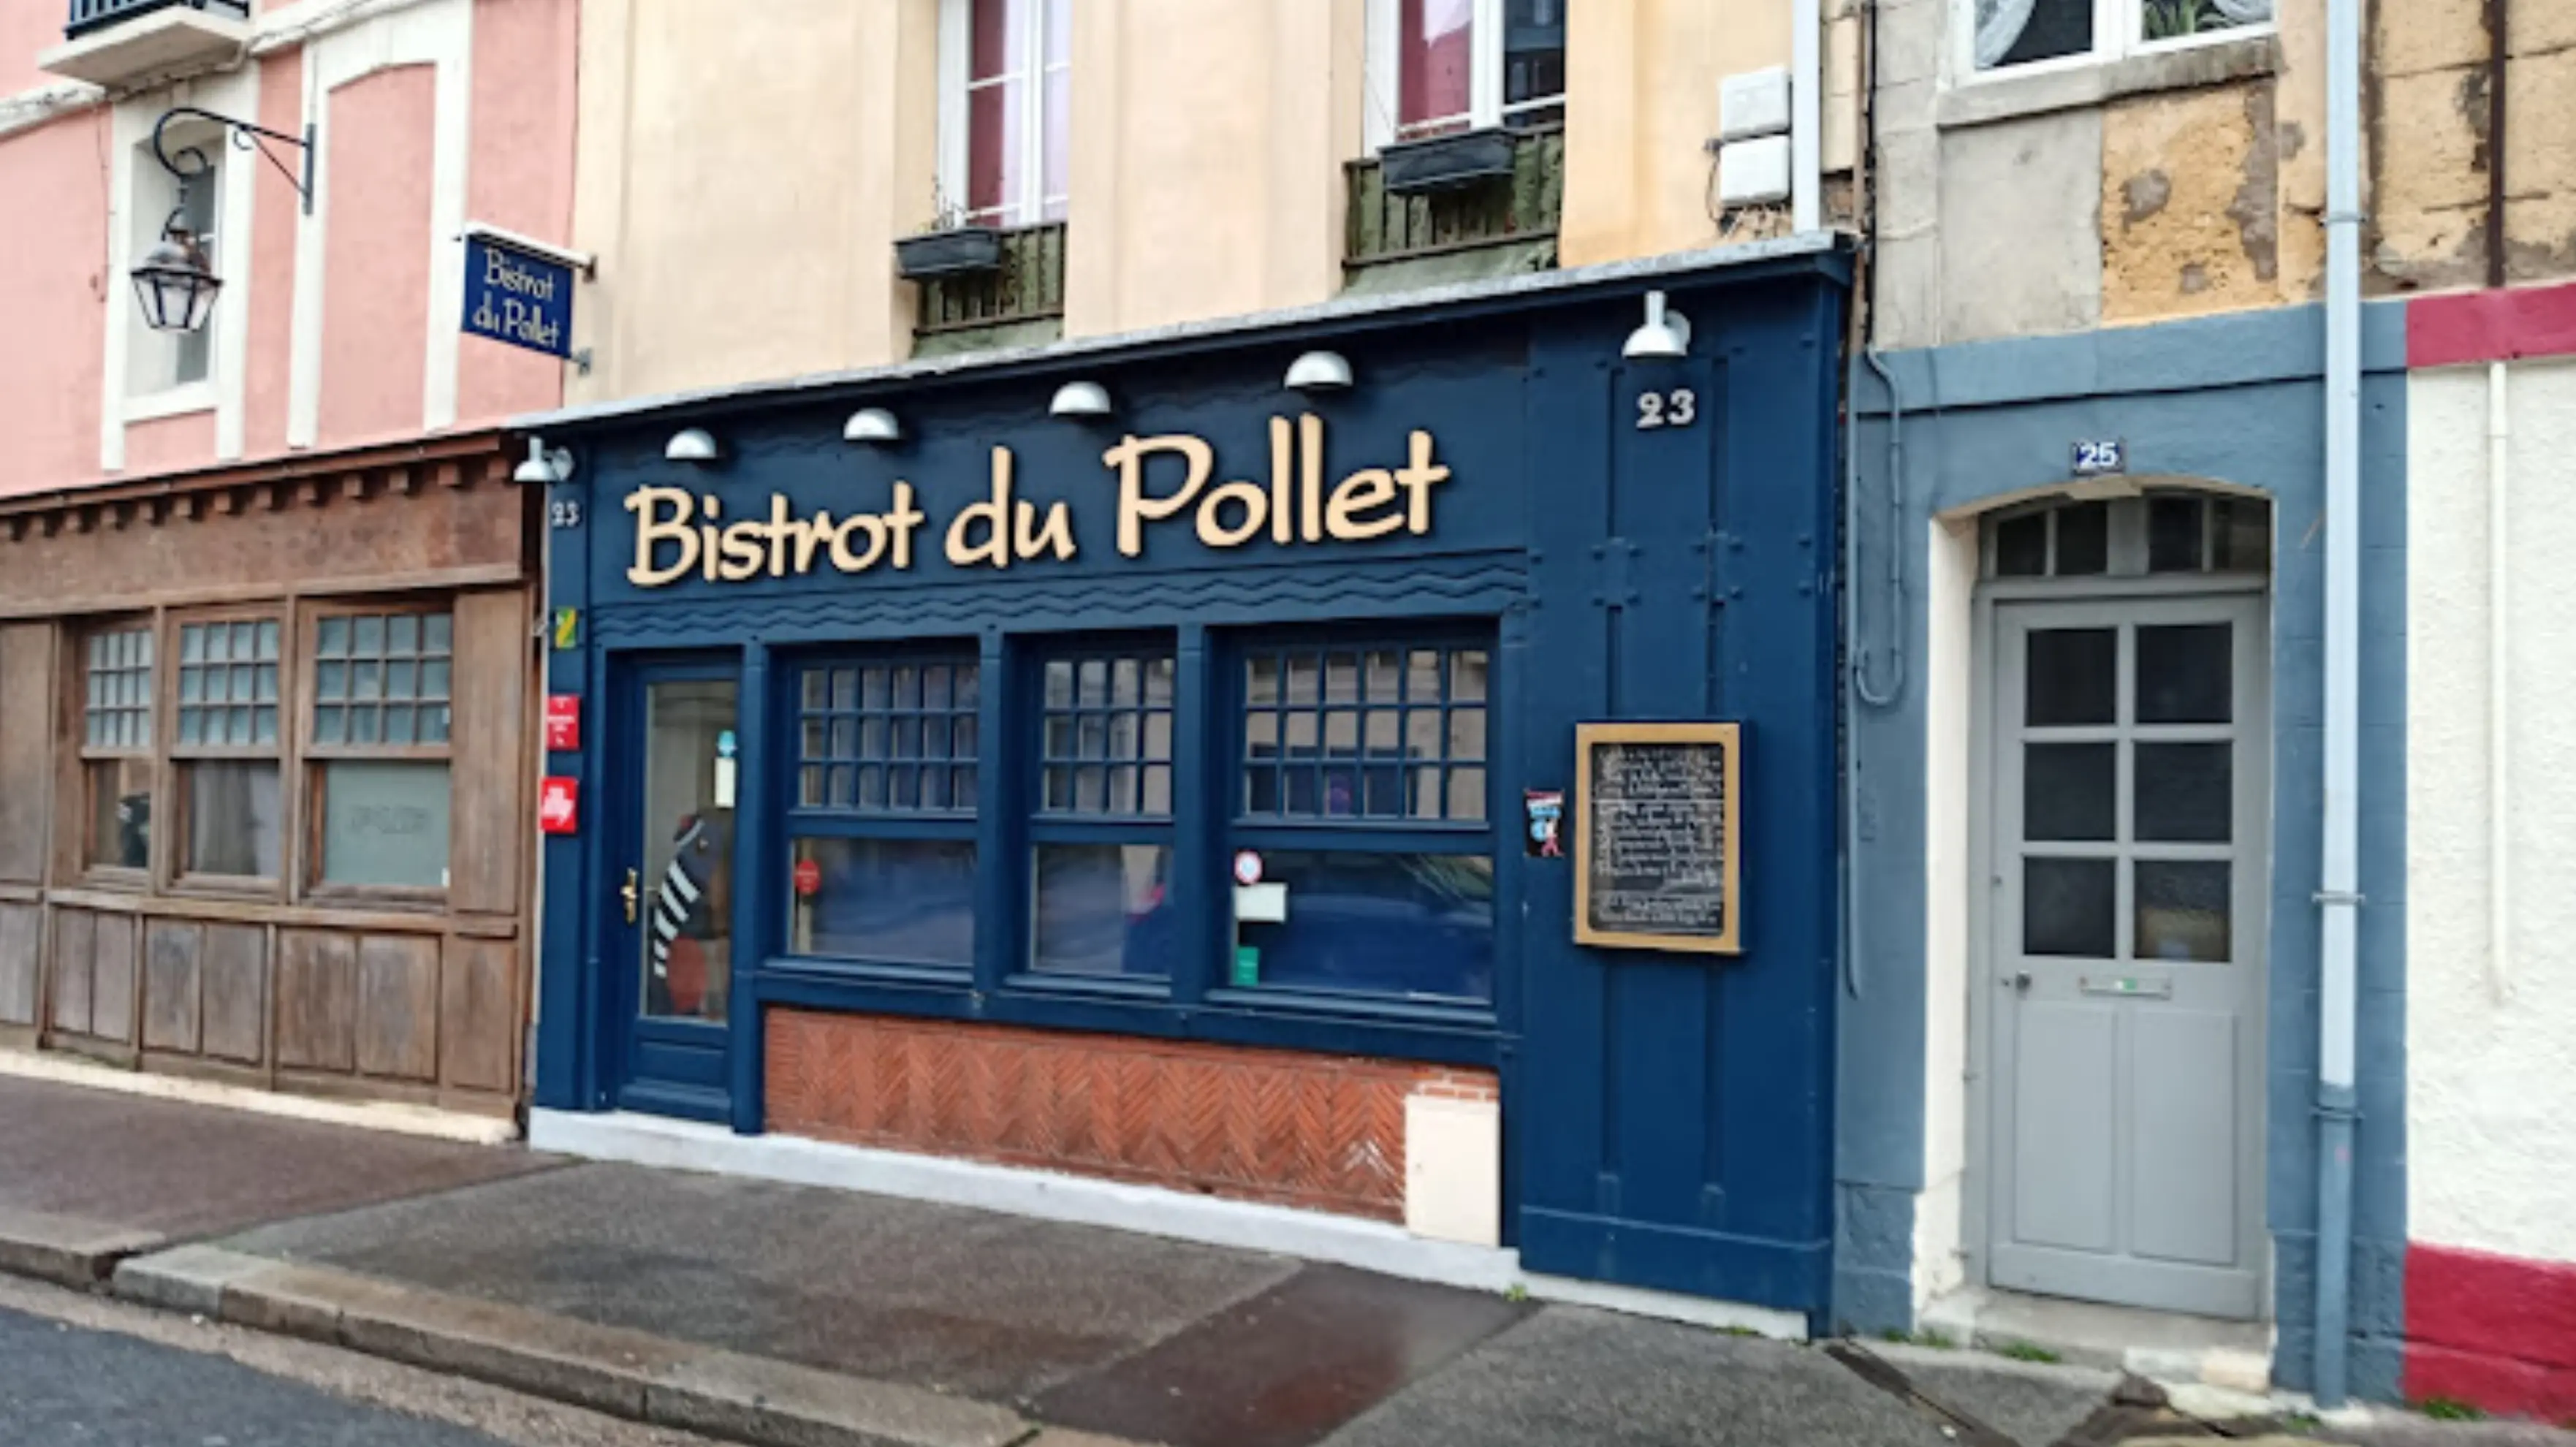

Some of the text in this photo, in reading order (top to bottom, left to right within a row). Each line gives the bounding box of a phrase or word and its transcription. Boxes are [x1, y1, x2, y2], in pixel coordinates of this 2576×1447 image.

[485, 246, 554, 302] Bistrot
[473, 290, 560, 349] du Pollet
[1636, 388, 1695, 428] 23
[2078, 440, 2118, 468] 25
[552, 501, 580, 527] 23
[623, 411, 1451, 588] Bistrot du Pollet
